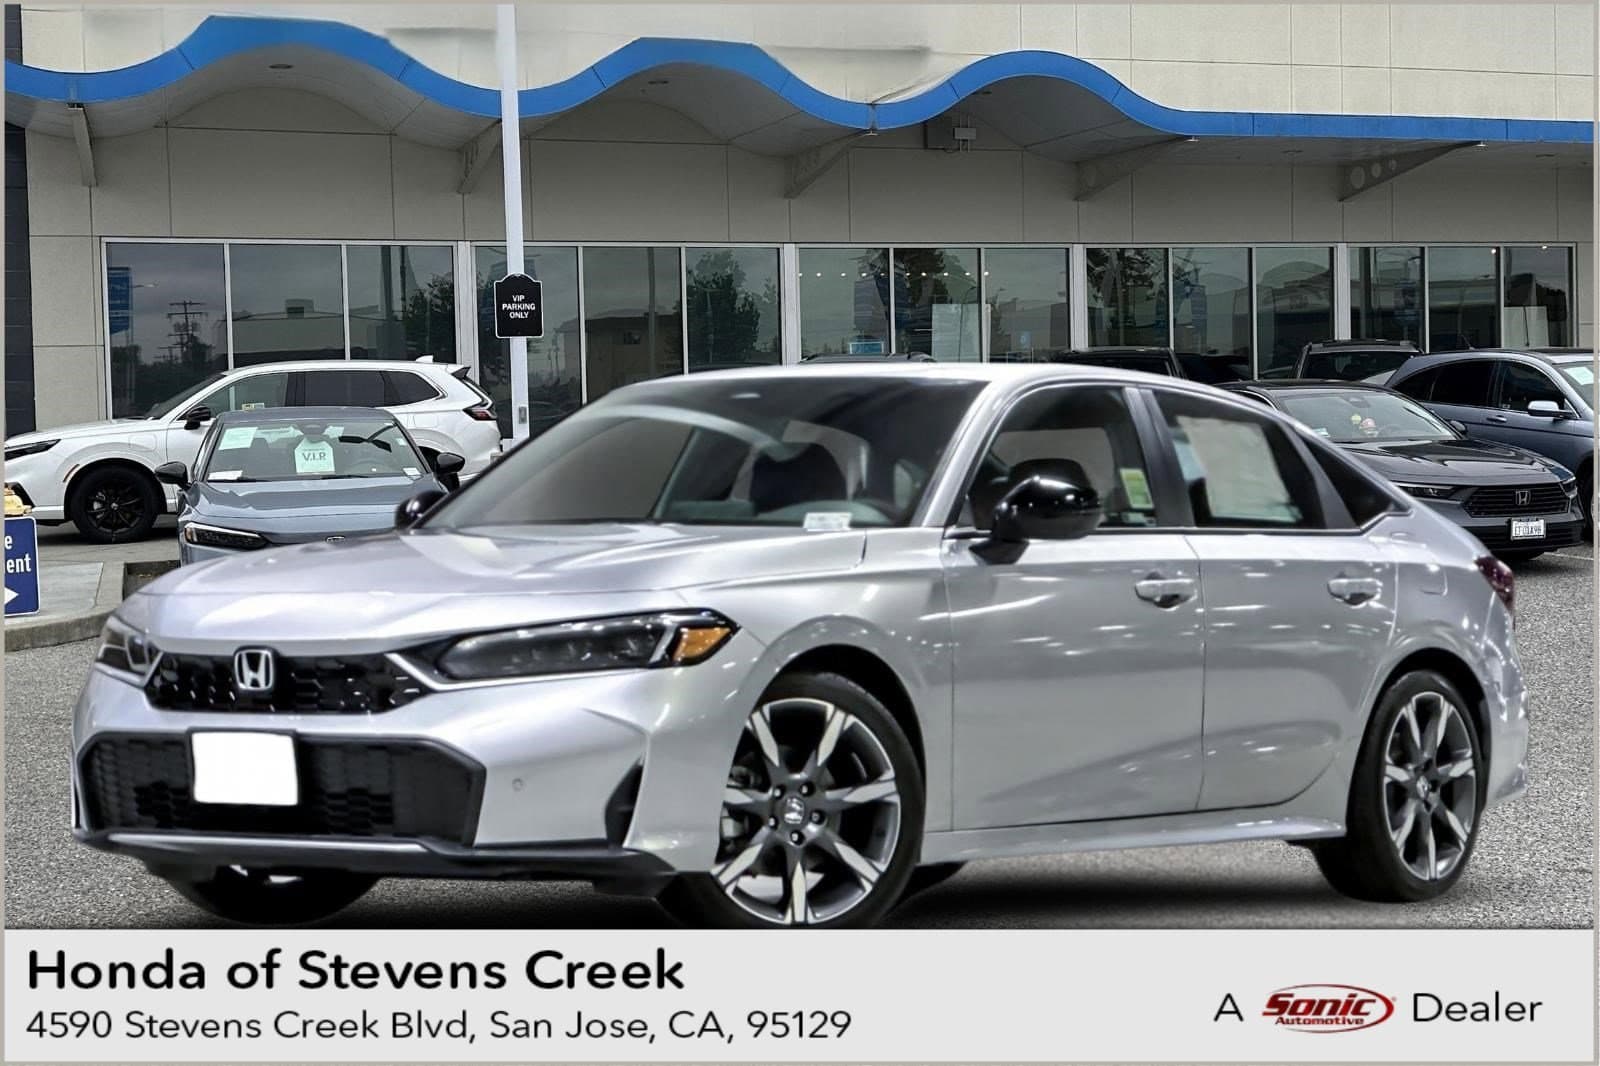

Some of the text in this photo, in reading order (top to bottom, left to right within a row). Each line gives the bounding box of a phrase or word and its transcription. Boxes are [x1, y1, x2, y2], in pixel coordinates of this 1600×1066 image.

[512, 294, 525, 302] VIP
[502, 303, 536, 311] PARKING
[509, 311, 529, 319] ONLY
